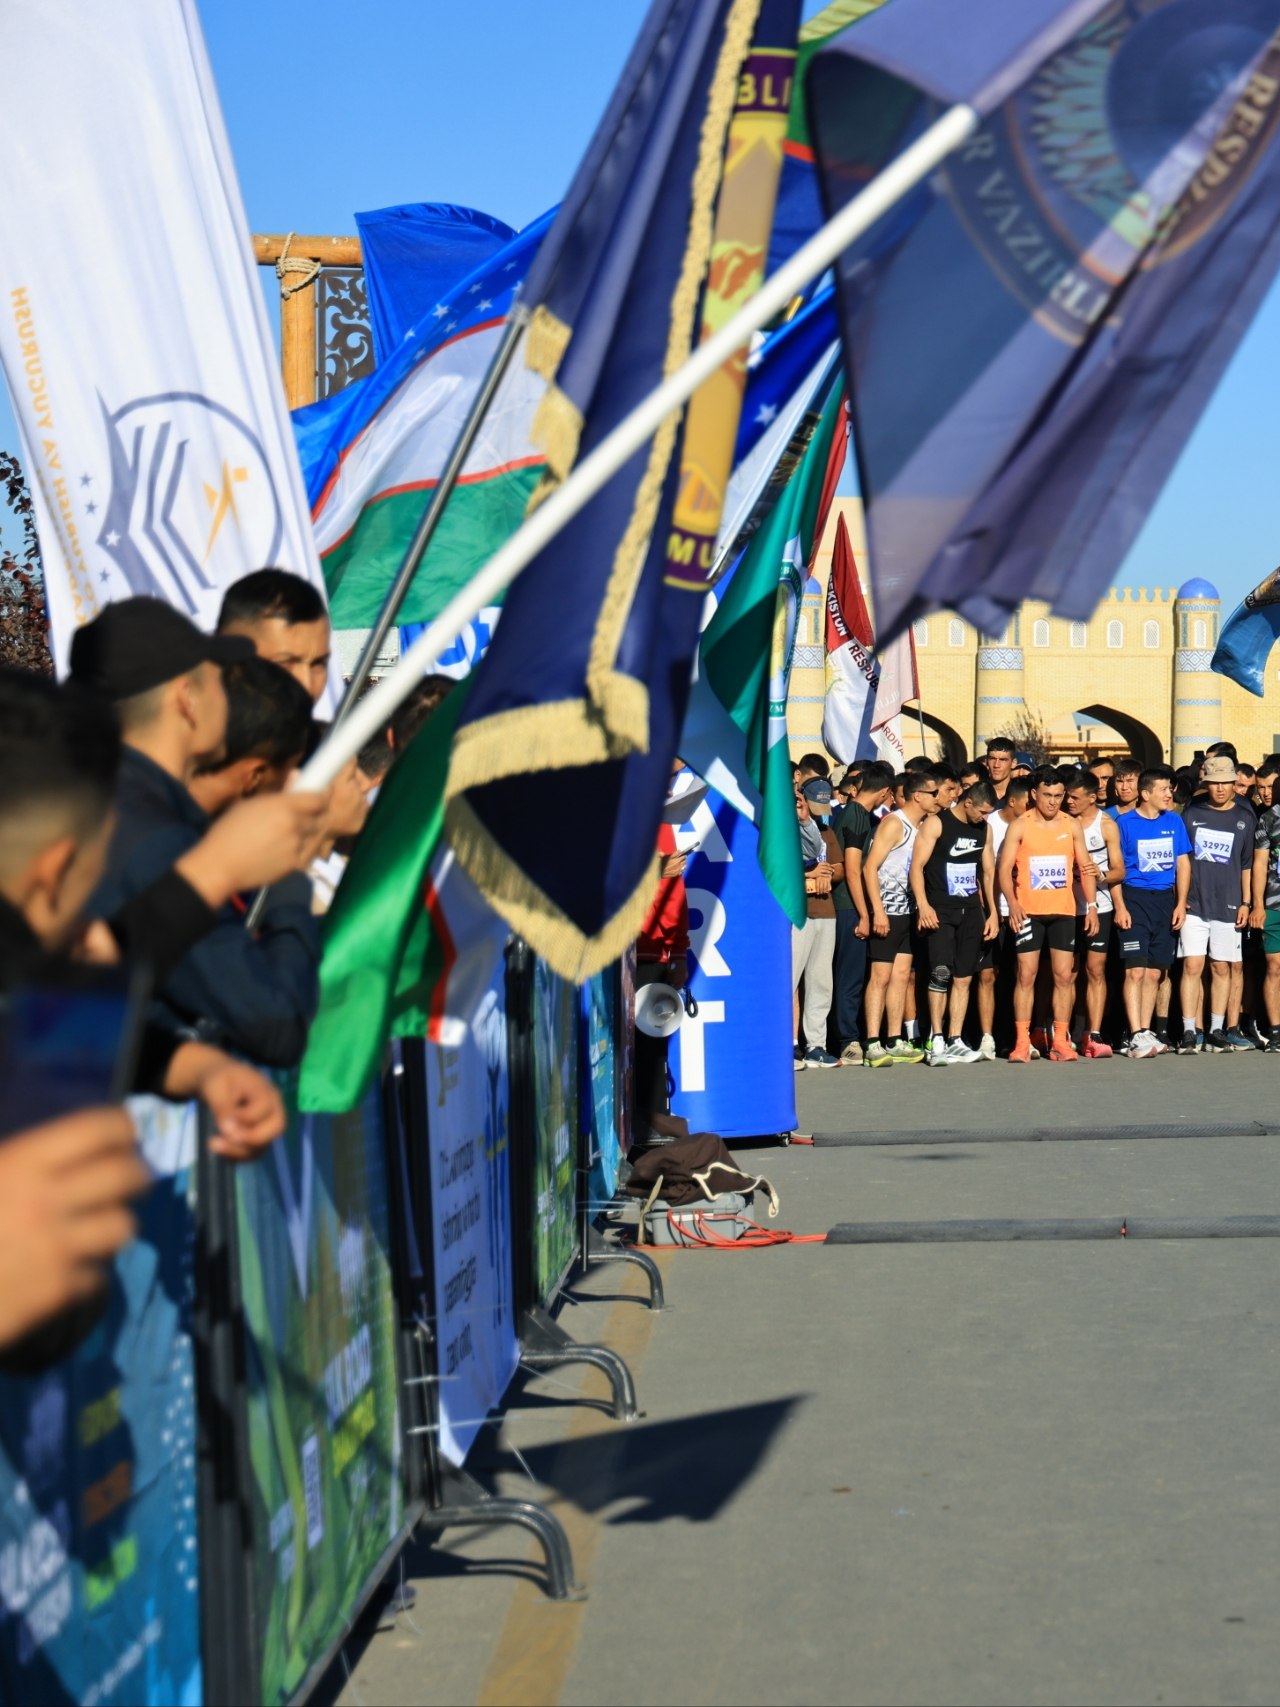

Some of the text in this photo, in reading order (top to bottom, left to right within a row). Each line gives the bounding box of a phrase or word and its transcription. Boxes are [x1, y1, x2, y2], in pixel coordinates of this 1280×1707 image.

[848, 643, 879, 695] RESPUB
[956, 837, 978, 849] NIKE
[1202, 840, 1230, 853] 32972
[1146, 850, 1173, 860] 32966
[1039, 867, 1066, 877] 32862
